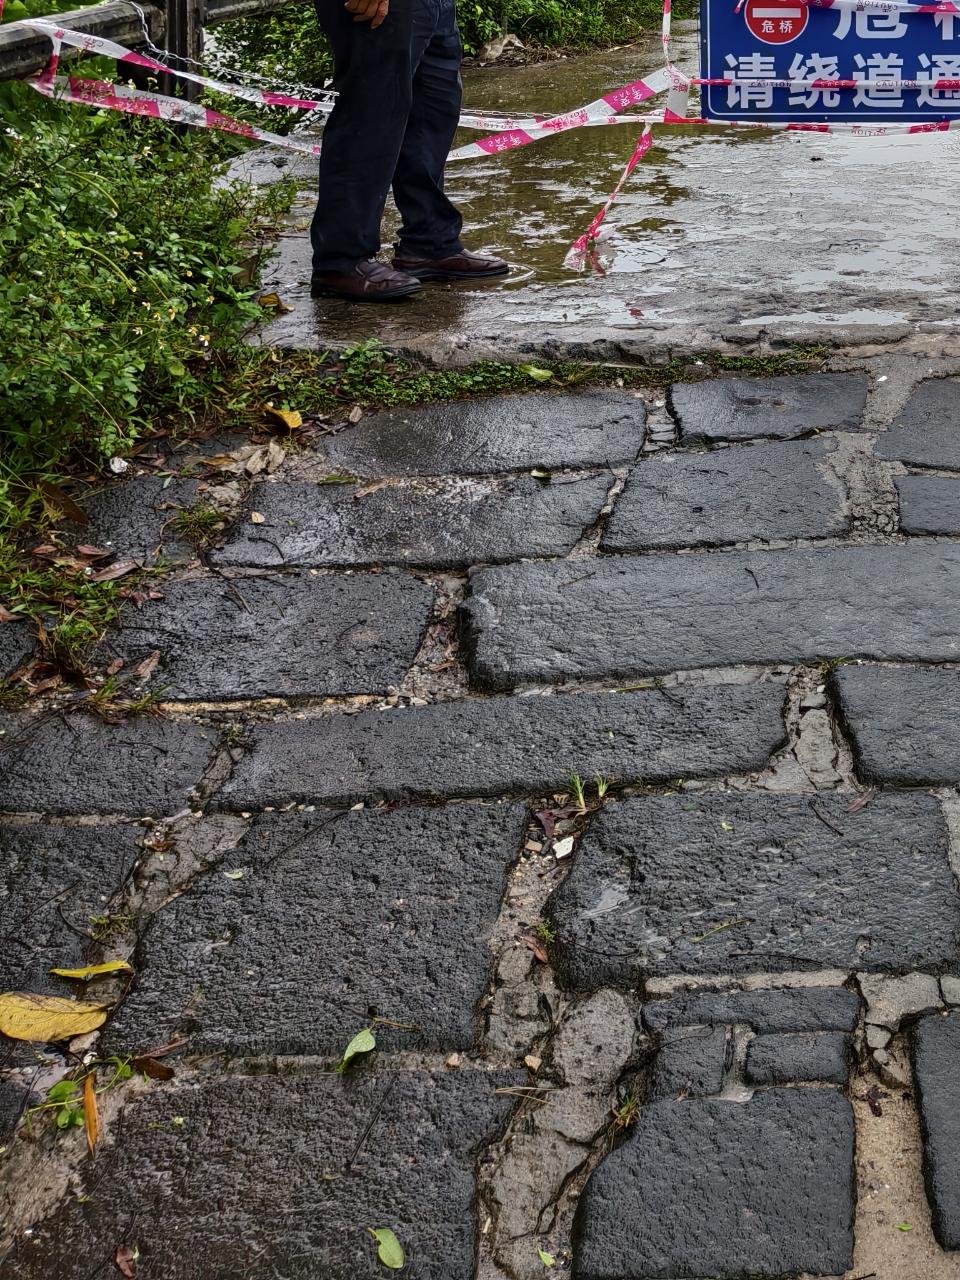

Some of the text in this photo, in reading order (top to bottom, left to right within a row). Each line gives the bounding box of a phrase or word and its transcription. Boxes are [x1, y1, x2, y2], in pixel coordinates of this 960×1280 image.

[761, 19, 793, 34] 危桥
[750, 79, 792, 88] CAUTION
[875, 80, 919, 88] CAUTION
